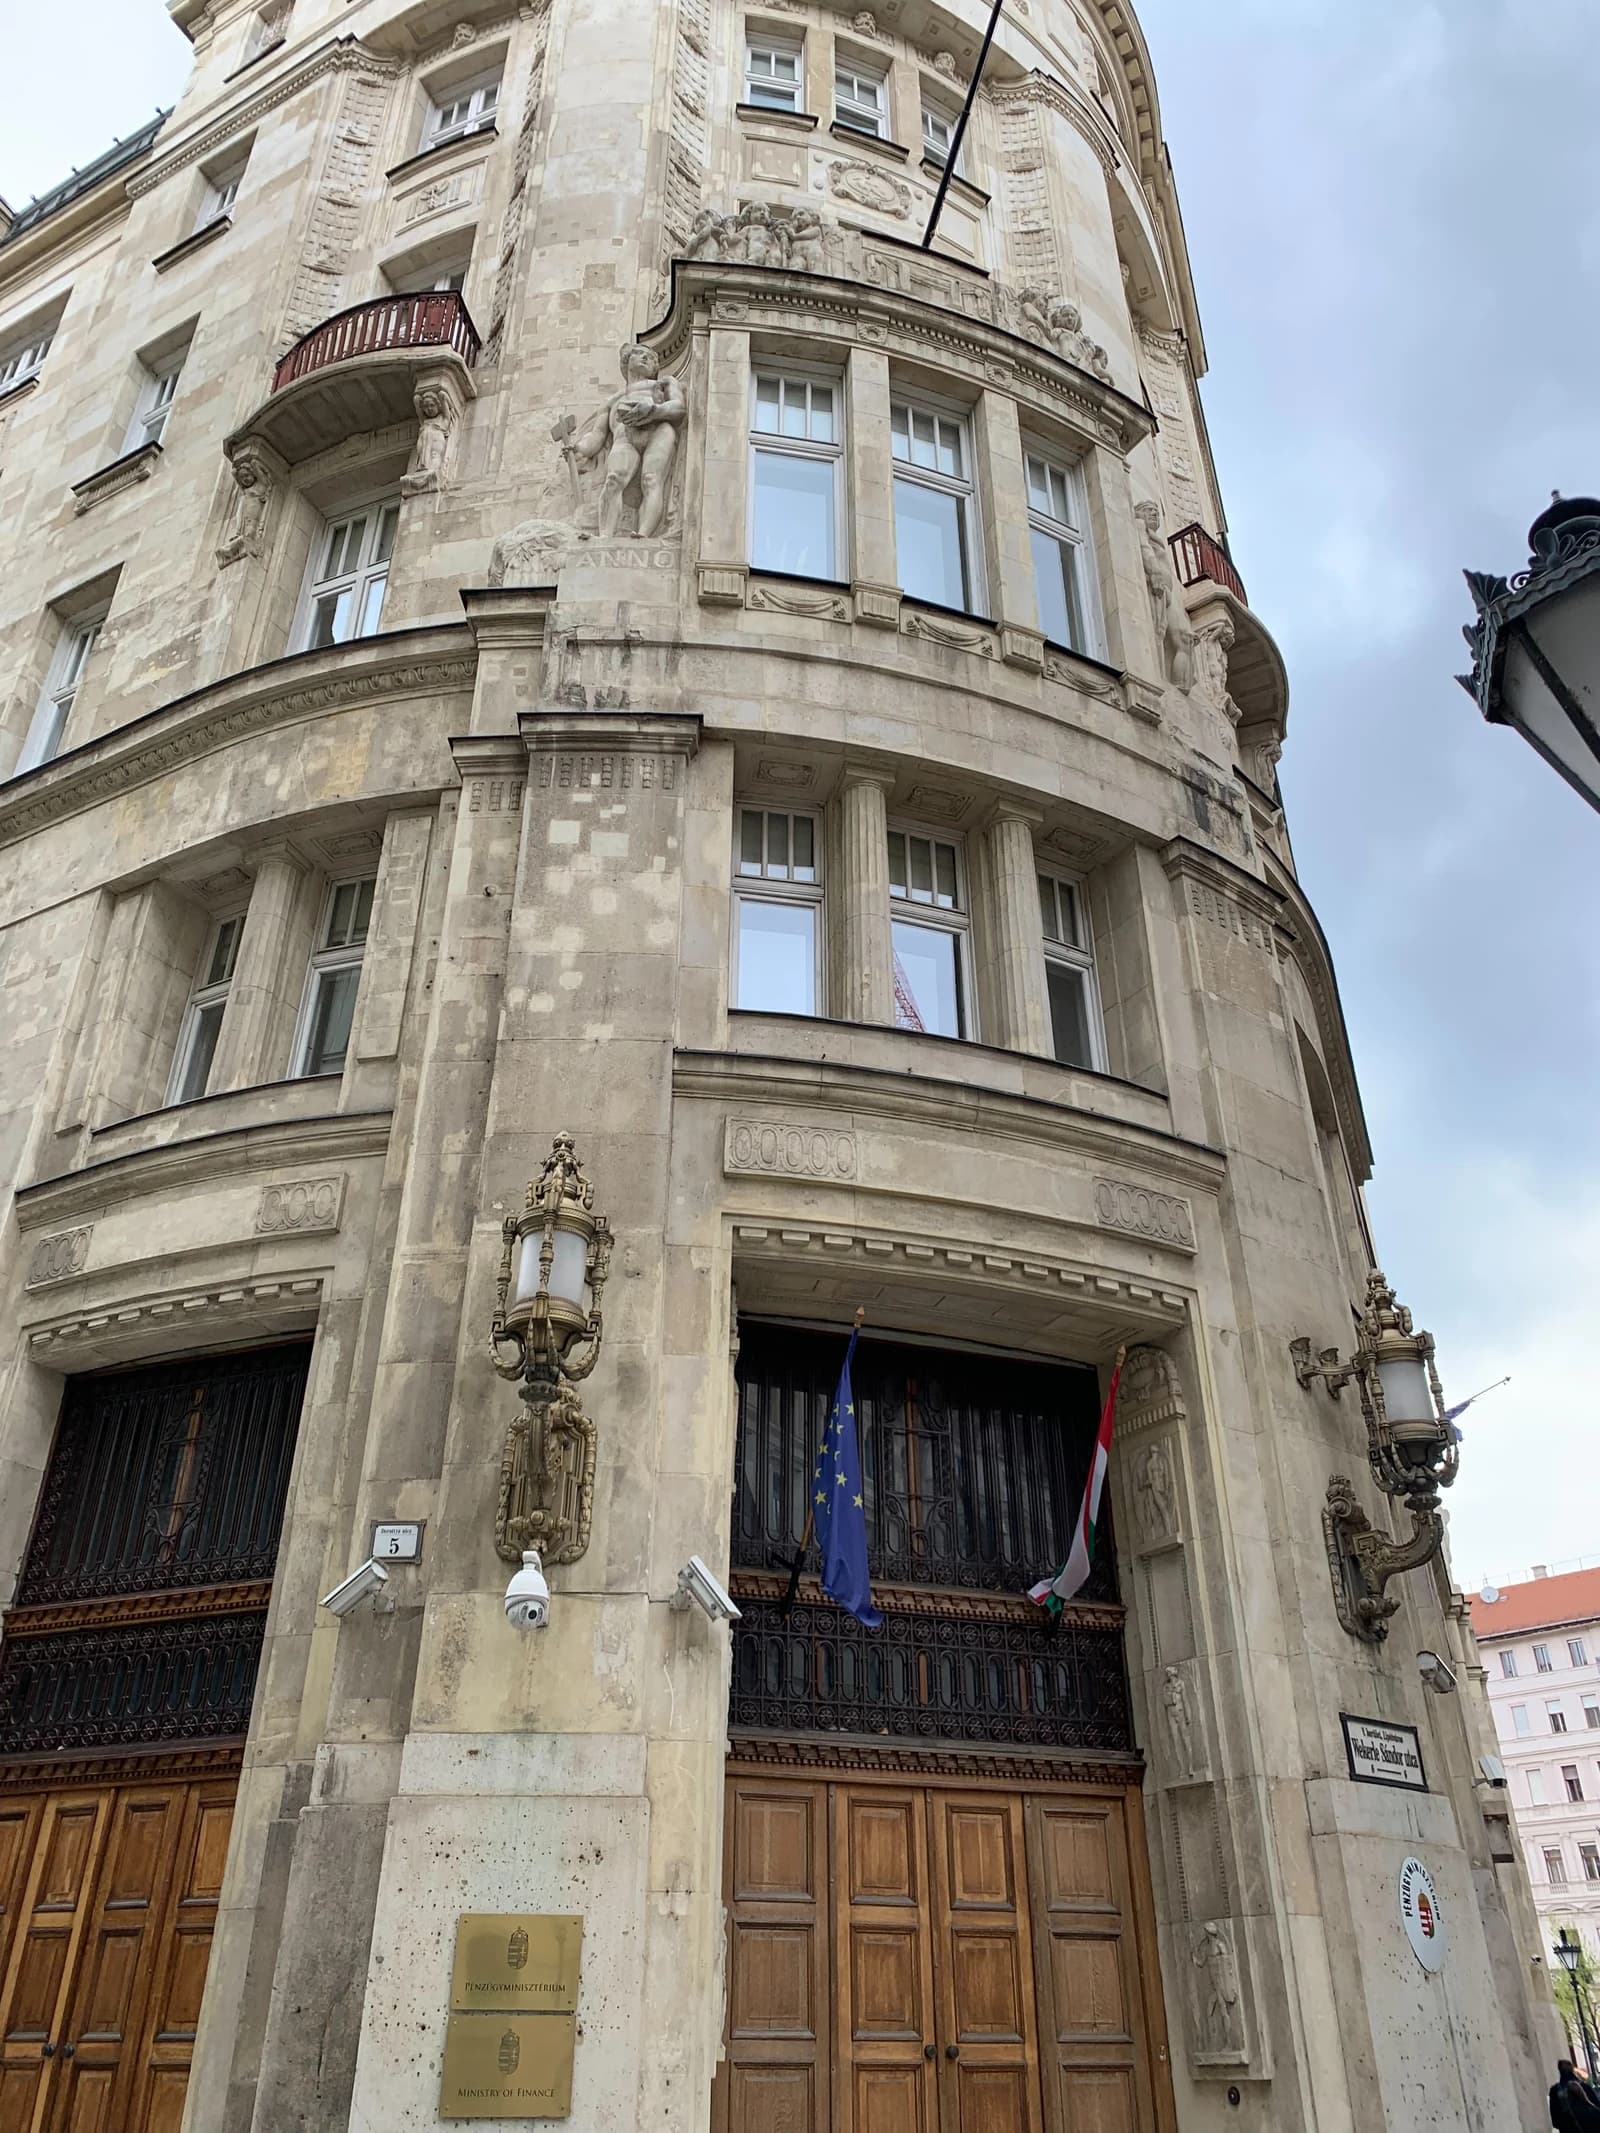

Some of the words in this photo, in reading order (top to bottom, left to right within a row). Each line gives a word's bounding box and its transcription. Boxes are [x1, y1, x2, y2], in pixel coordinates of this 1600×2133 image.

[575, 549, 675, 569] ANNO
[389, 1537, 400, 1555] 5
[1351, 1737, 1380, 1762] Wekerle
[1379, 1742, 1404, 1766] Sándor
[1404, 1747, 1419, 1769] utca
[457, 2087, 499, 2098] MINISTRY
[502, 2087, 513, 2098] OF
[517, 2087, 555, 2098] FINANCE
